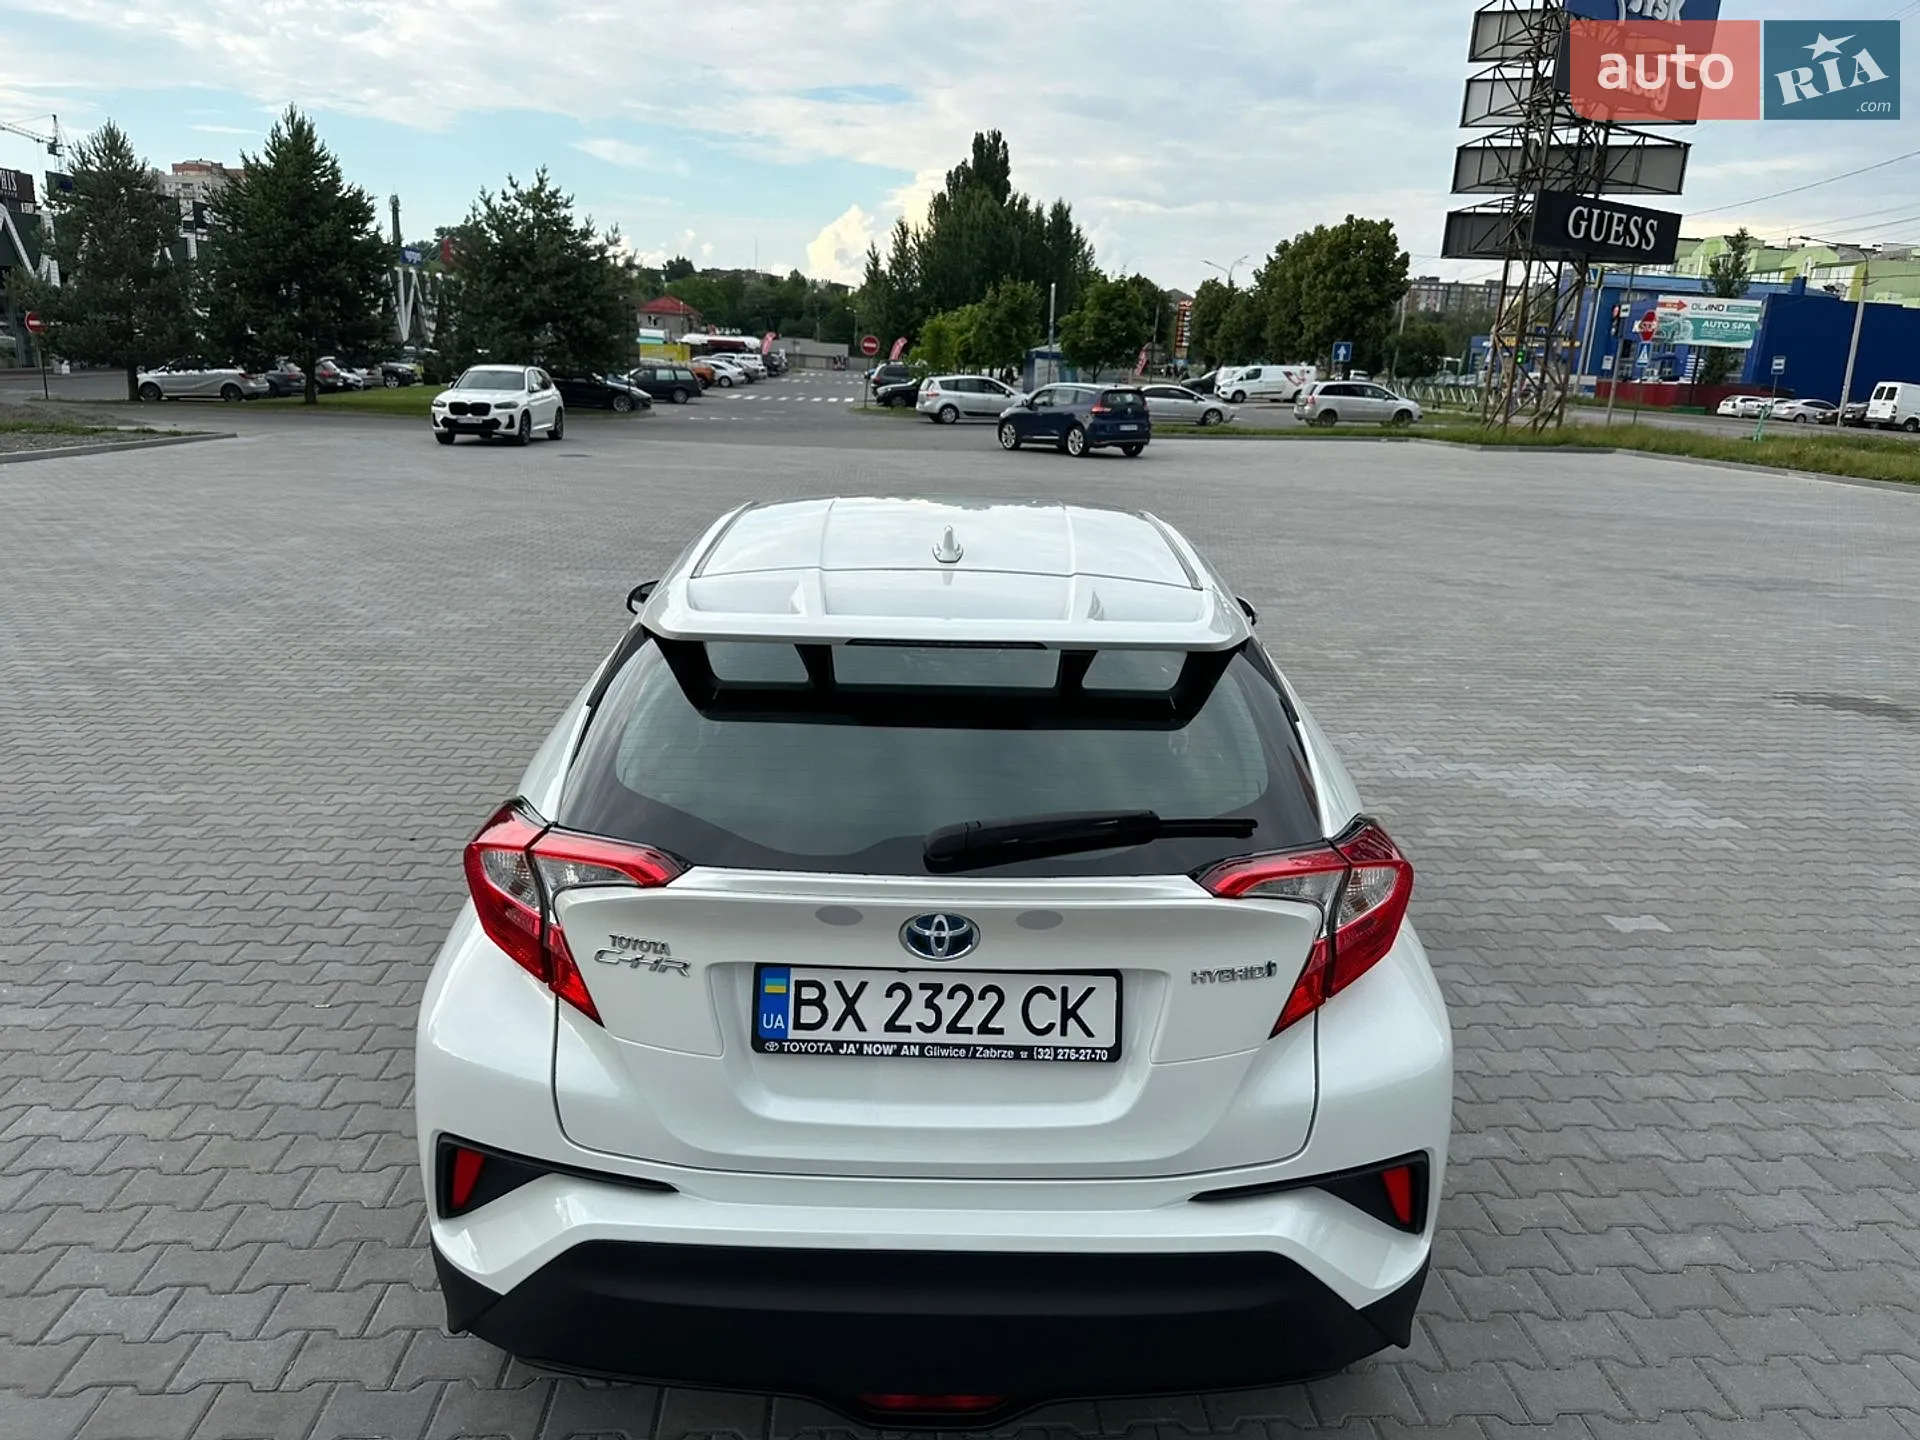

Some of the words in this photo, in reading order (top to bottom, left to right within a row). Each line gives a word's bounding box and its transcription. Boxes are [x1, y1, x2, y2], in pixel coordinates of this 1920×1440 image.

[1567, 205, 1659, 252] GUESS
[1702, 319, 1729, 330] AUTO
[1730, 321, 1752, 331] SPA
[608, 934, 672, 956] TOYOTA
[1190, 965, 1265, 985] HYBRID
[792, 979, 869, 1033] BX
[883, 981, 1006, 1036] 2322
[1021, 985, 1097, 1038] CK
[762, 1013, 786, 1030] UA
[782, 1041, 834, 1054] TOYOTA
[900, 1045, 919, 1057] AN
[923, 1045, 967, 1058] Gliwice
[975, 1046, 1015, 1059] Zabrze
[1033, 1046, 1055, 1061] (32)
[1057, 1048, 1109, 1062] 276-27-70
